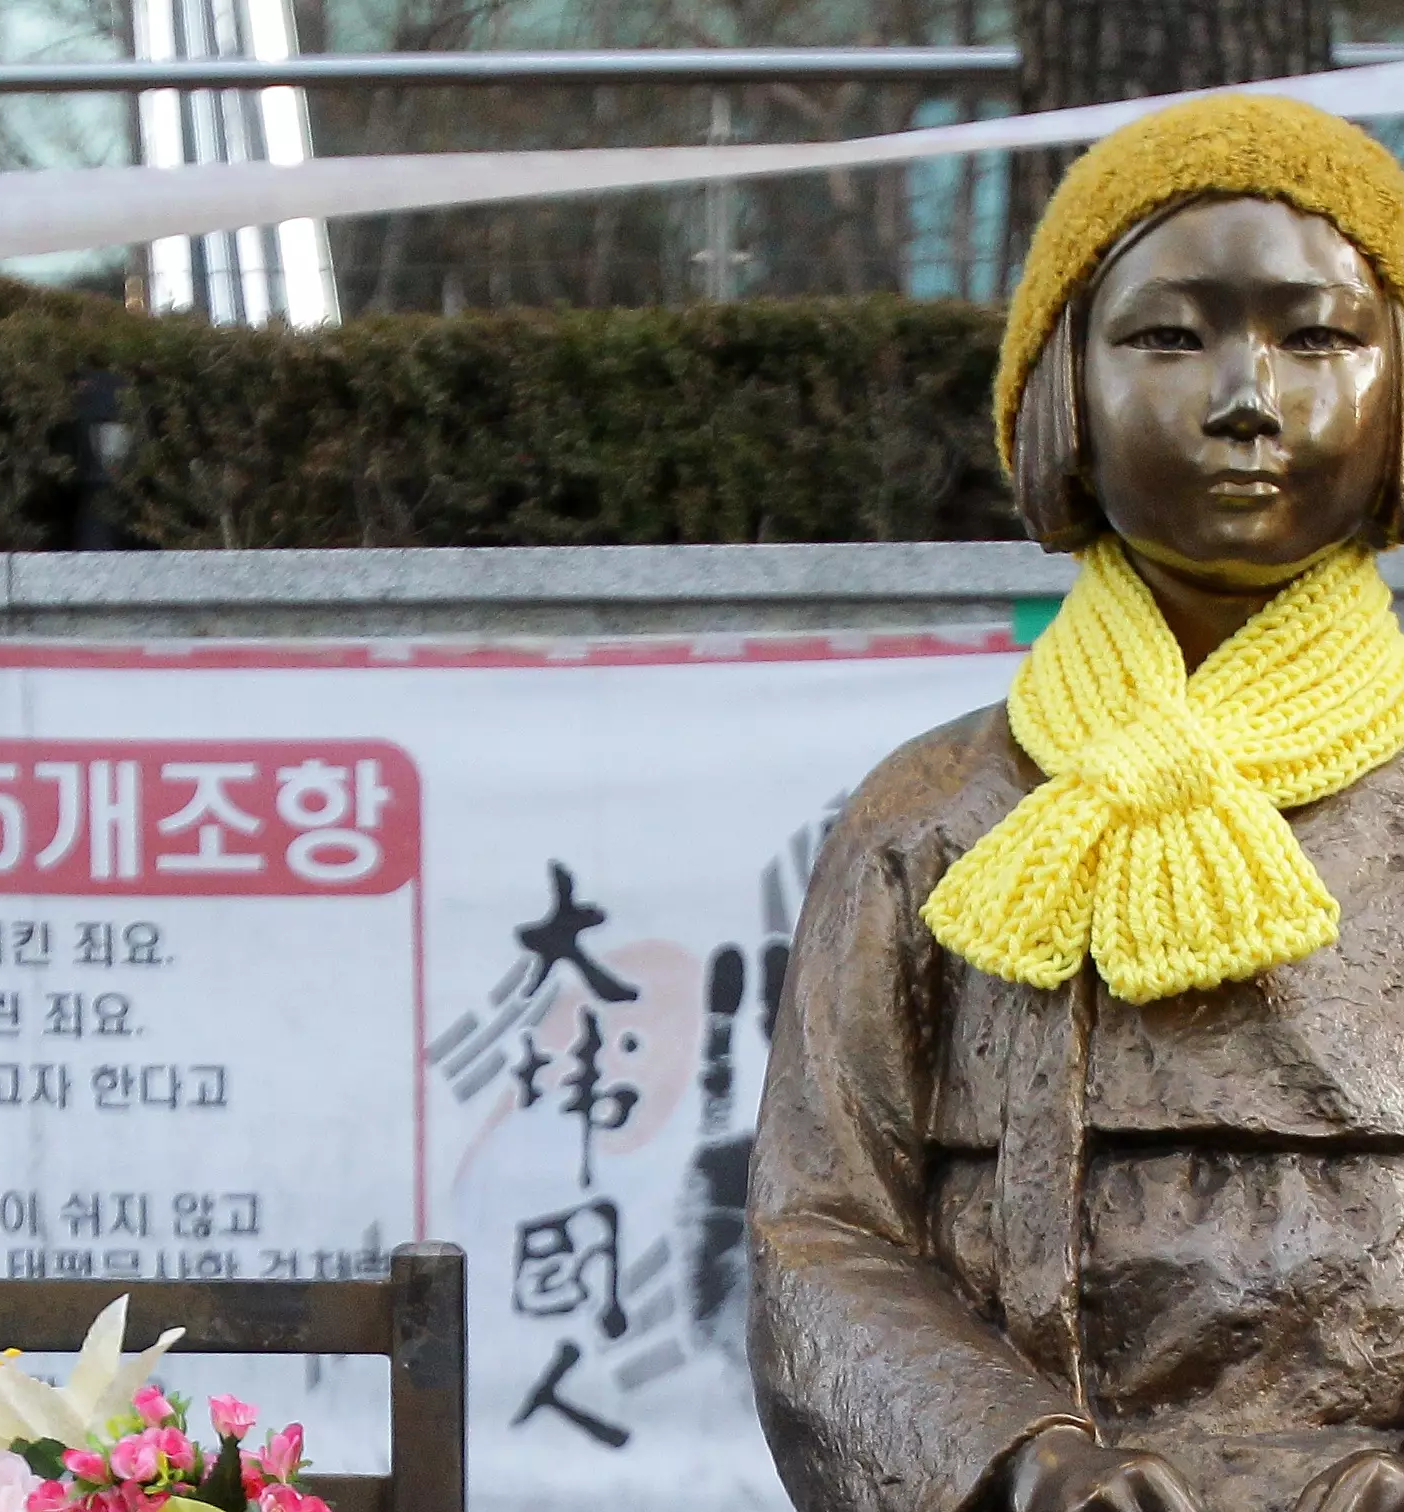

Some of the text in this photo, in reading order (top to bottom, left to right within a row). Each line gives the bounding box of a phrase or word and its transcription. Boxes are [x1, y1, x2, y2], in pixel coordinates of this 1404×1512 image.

[74, 922, 173, 969] 죄요.
[43, 992, 143, 1040] 죄요.
[92, 1064, 228, 1112] 한다고
[61, 1192, 152, 1238] 쉬지
[172, 1192, 262, 1242] 않고
